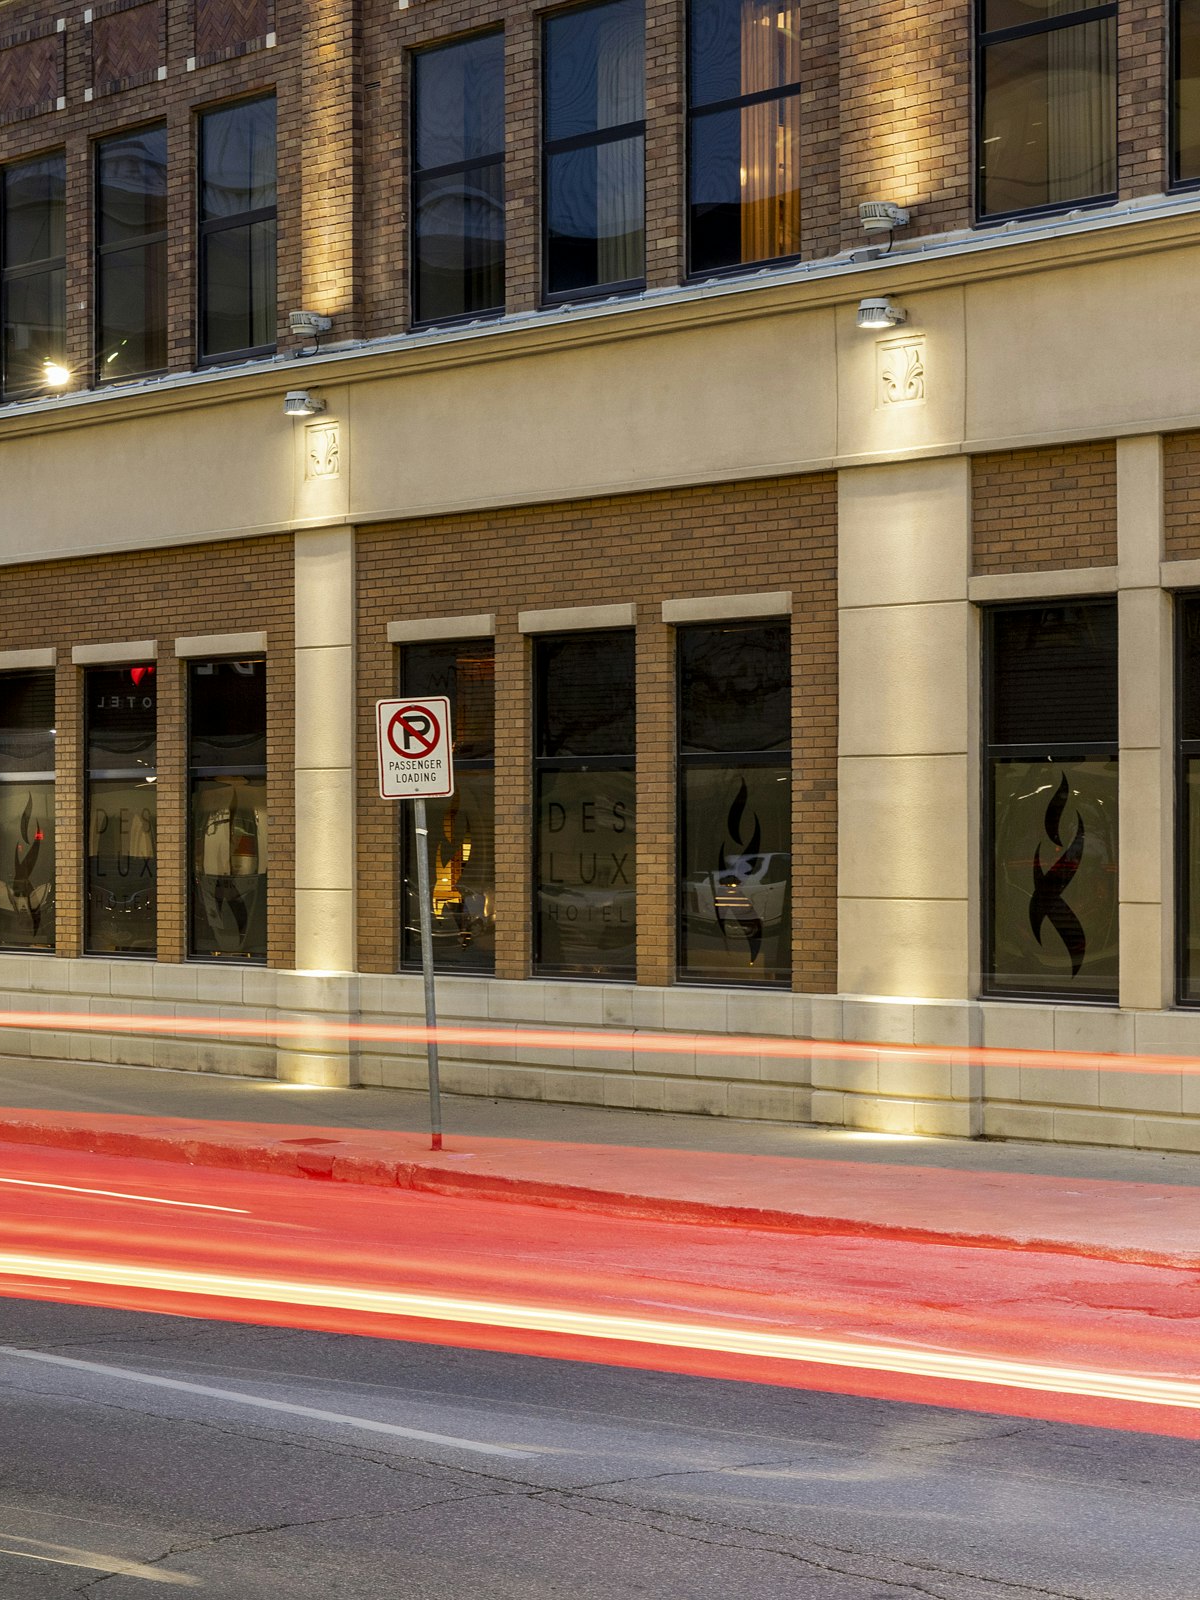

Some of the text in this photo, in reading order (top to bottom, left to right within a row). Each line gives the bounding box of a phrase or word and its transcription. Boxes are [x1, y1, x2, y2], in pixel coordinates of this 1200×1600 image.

[389, 760, 442, 771] PASSENGER
[396, 772, 437, 783] LOADING
[96, 808, 151, 834] DES
[549, 802, 626, 833] DES
[97, 851, 152, 877] LUX
[550, 853, 628, 884] LUX
[549, 904, 628, 922] HOTEL
